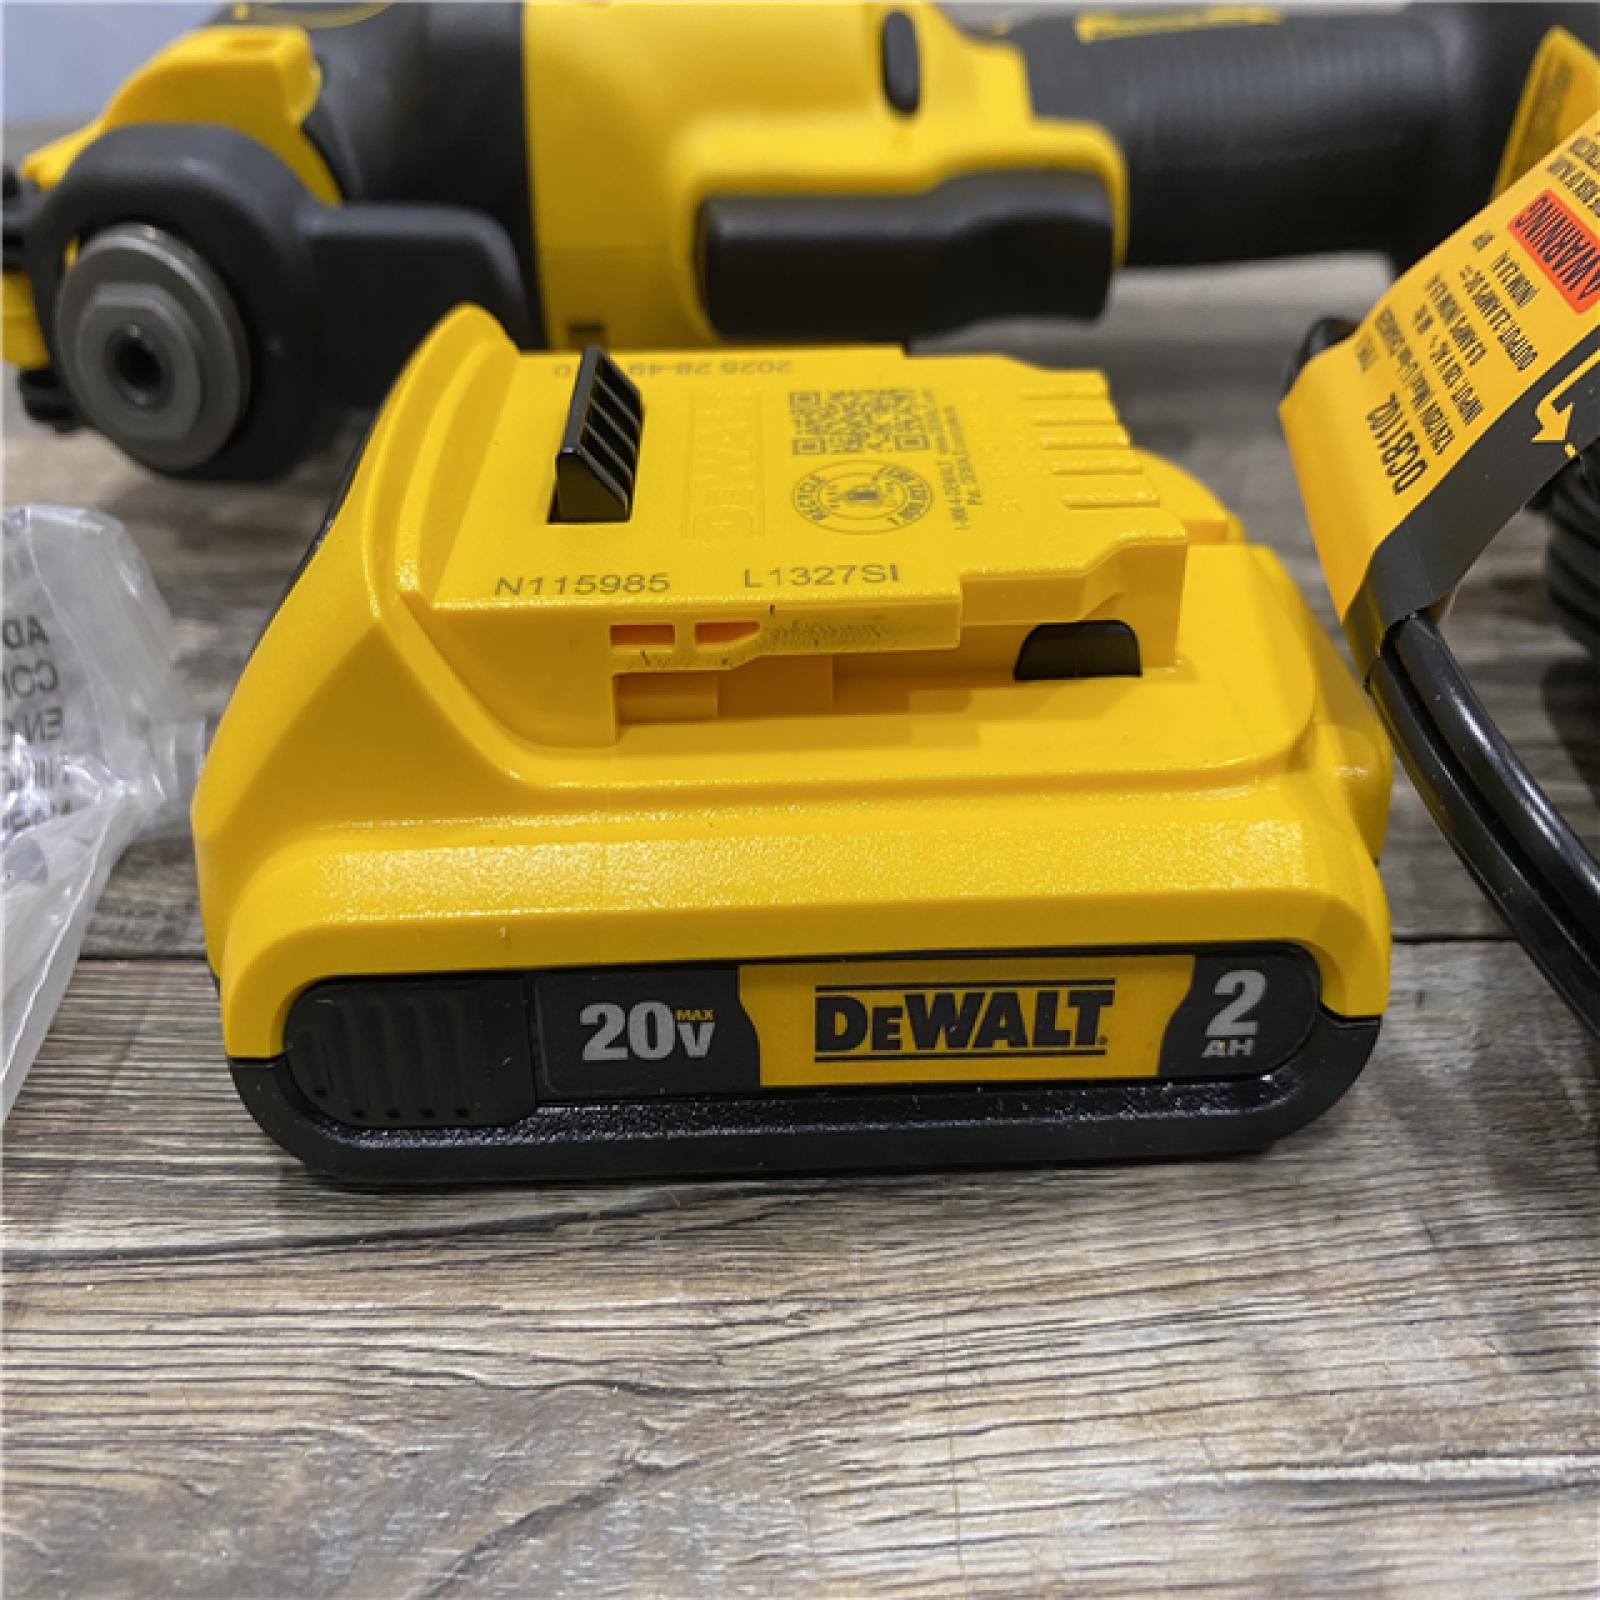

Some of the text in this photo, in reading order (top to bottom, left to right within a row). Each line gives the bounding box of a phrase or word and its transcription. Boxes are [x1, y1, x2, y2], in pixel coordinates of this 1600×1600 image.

[1515, 195, 1600, 292] WARNING
[1366, 392, 1428, 495] DCB1102
[495, 562, 899, 597] N115985 L1327SI
[579, 1001, 716, 1061] 20V MAX
[1201, 969, 1267, 1058] 2 AH
